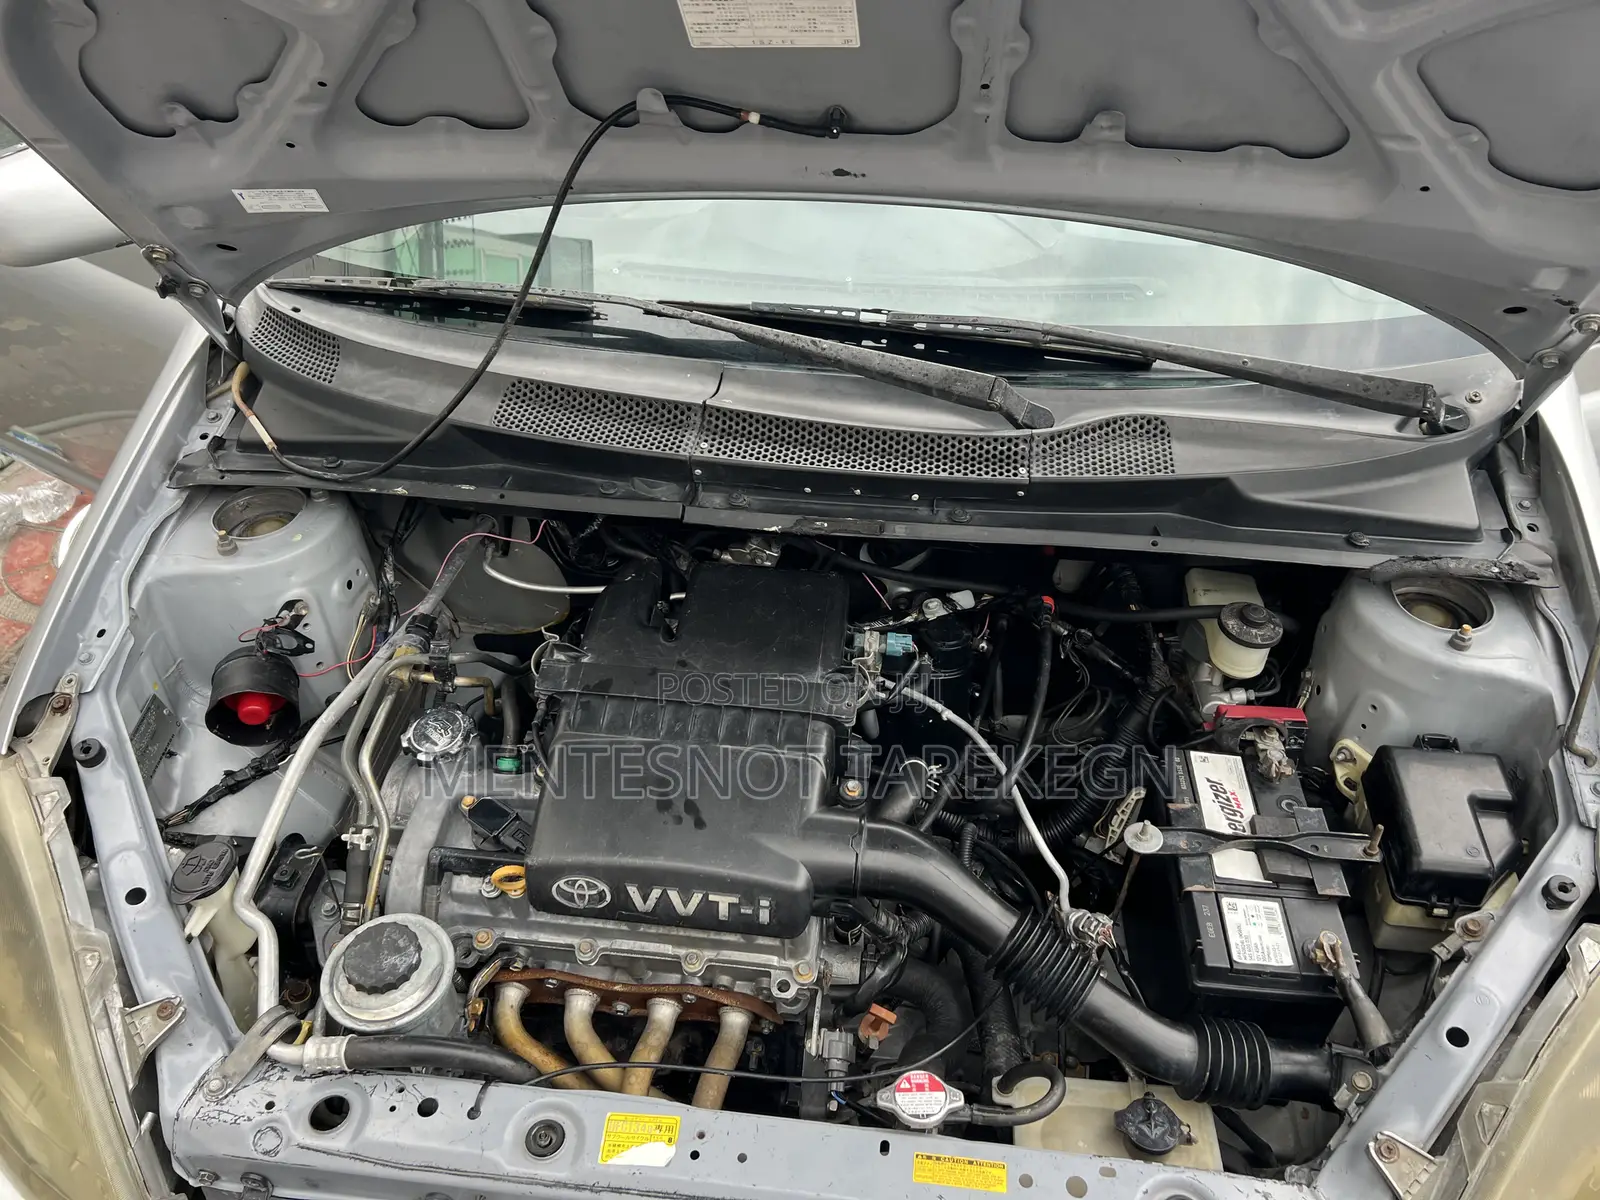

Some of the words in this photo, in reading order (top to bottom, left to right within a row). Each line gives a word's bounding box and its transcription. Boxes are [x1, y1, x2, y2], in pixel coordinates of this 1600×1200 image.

[1205, 777, 1246, 834] ergizer
[1229, 790, 1244, 810] MAX
[625, 883, 772, 924] VVT-i
